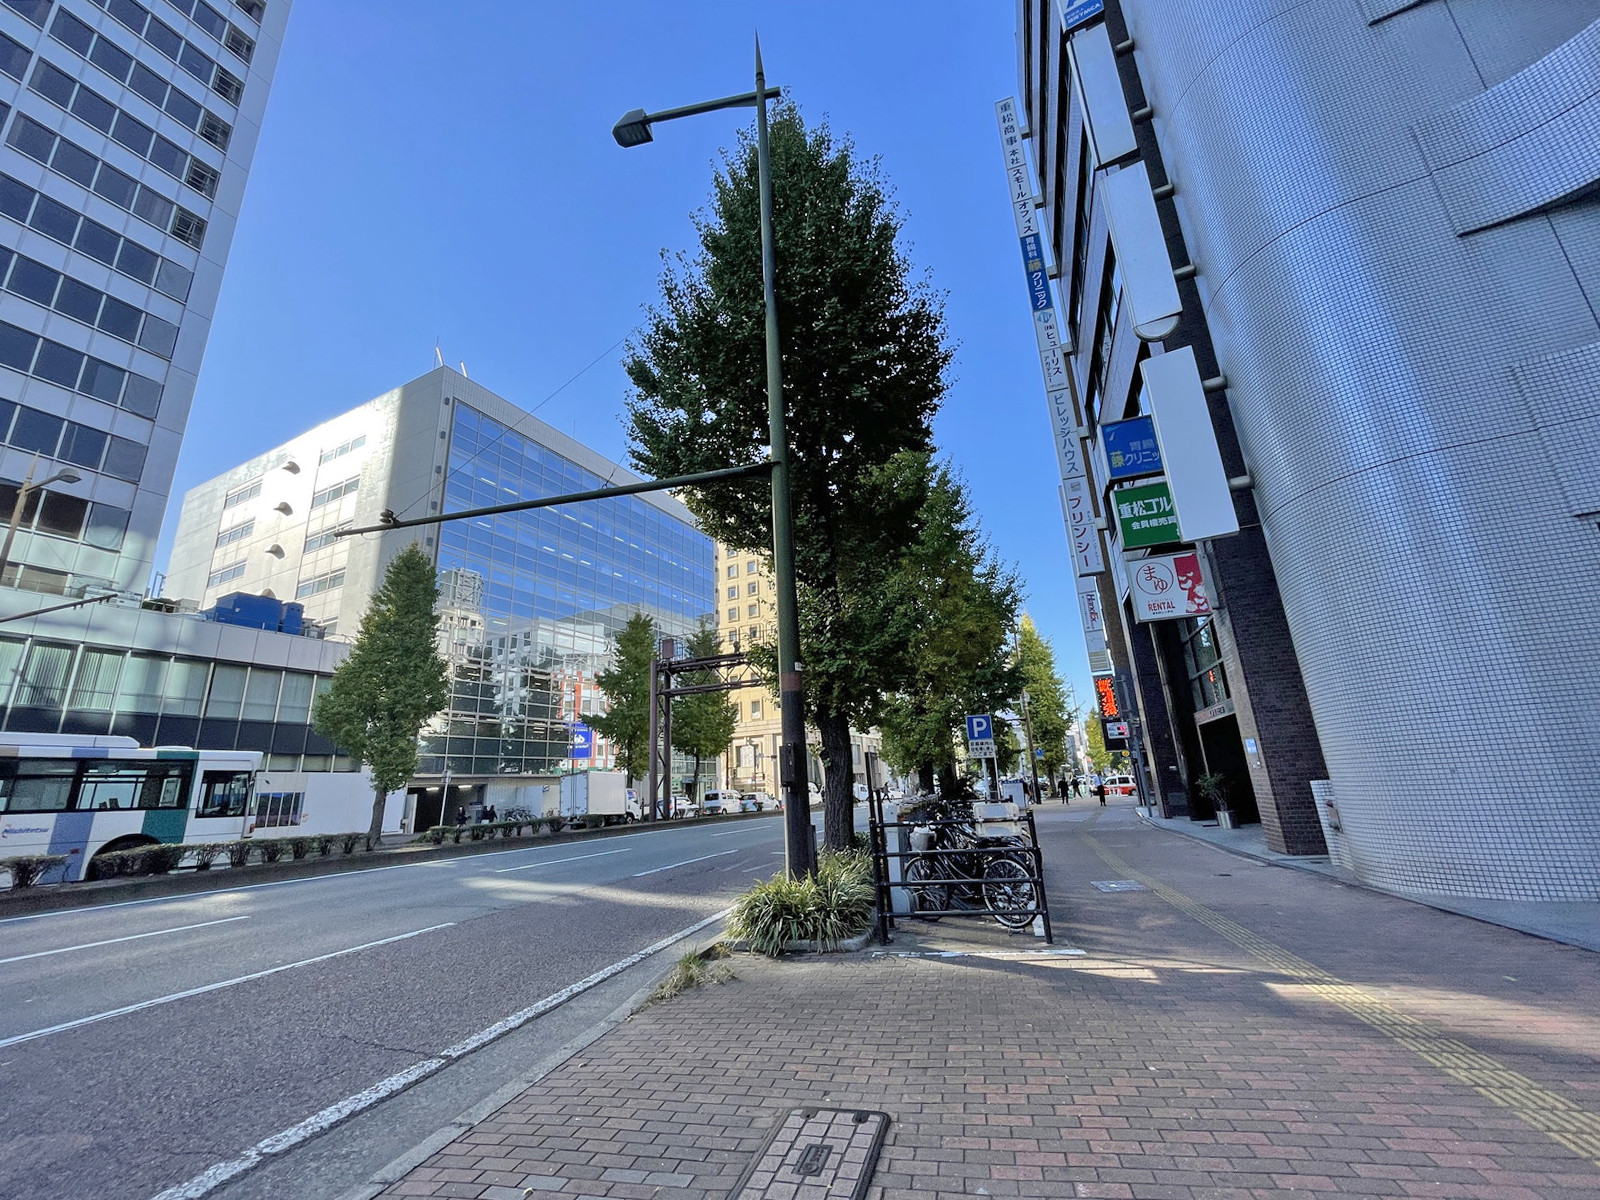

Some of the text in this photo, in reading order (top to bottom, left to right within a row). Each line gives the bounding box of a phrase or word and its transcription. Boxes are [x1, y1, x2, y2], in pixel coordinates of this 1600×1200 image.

[1054, 393, 1078, 474] ビレッジハウス
[1069, 495, 1089, 567] プリンシー
[1143, 565, 1169, 593] まゆ
[1147, 601, 1176, 612] RENTAL
[972, 718, 987, 737] P
